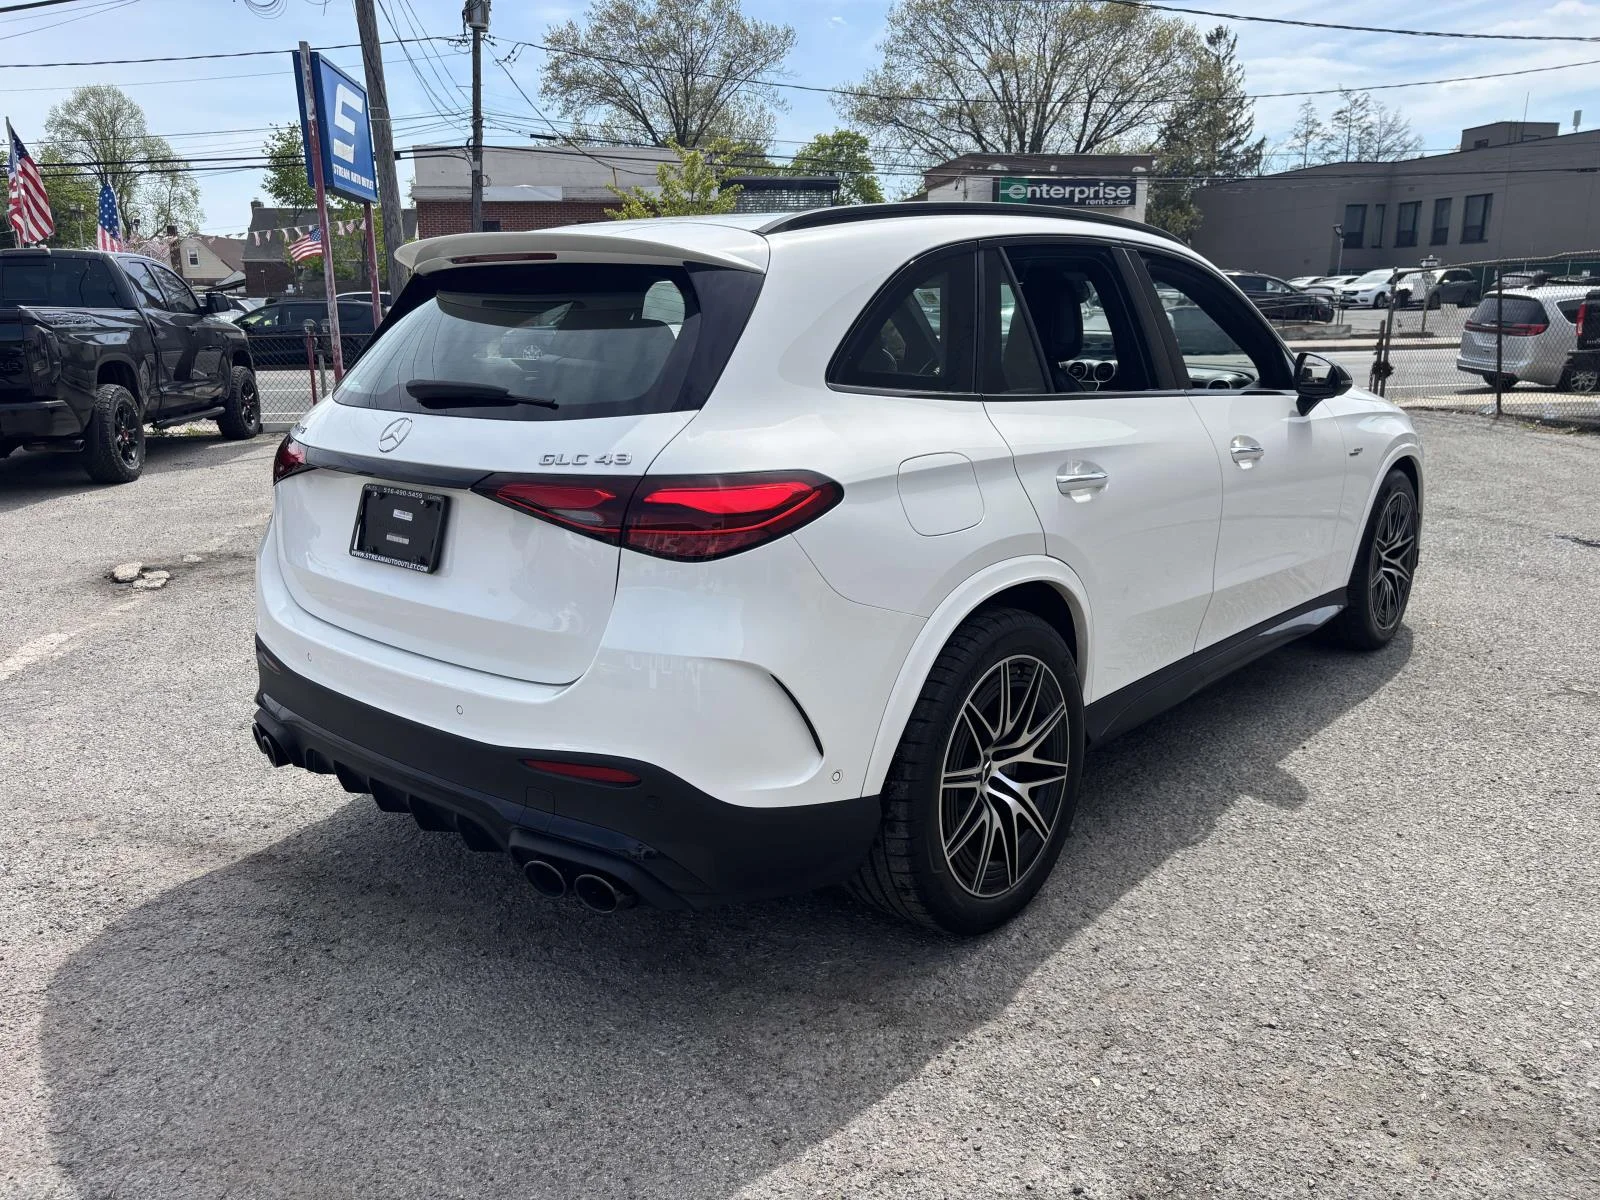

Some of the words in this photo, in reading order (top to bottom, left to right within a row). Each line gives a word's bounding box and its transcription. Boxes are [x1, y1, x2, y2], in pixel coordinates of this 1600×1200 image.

[1008, 182, 1132, 203] enterprise
[539, 453, 589, 466] GLC
[594, 453, 633, 466] 43
[351, 549, 429, 572] WWW.STREAMAUTOOUTLET.COM
